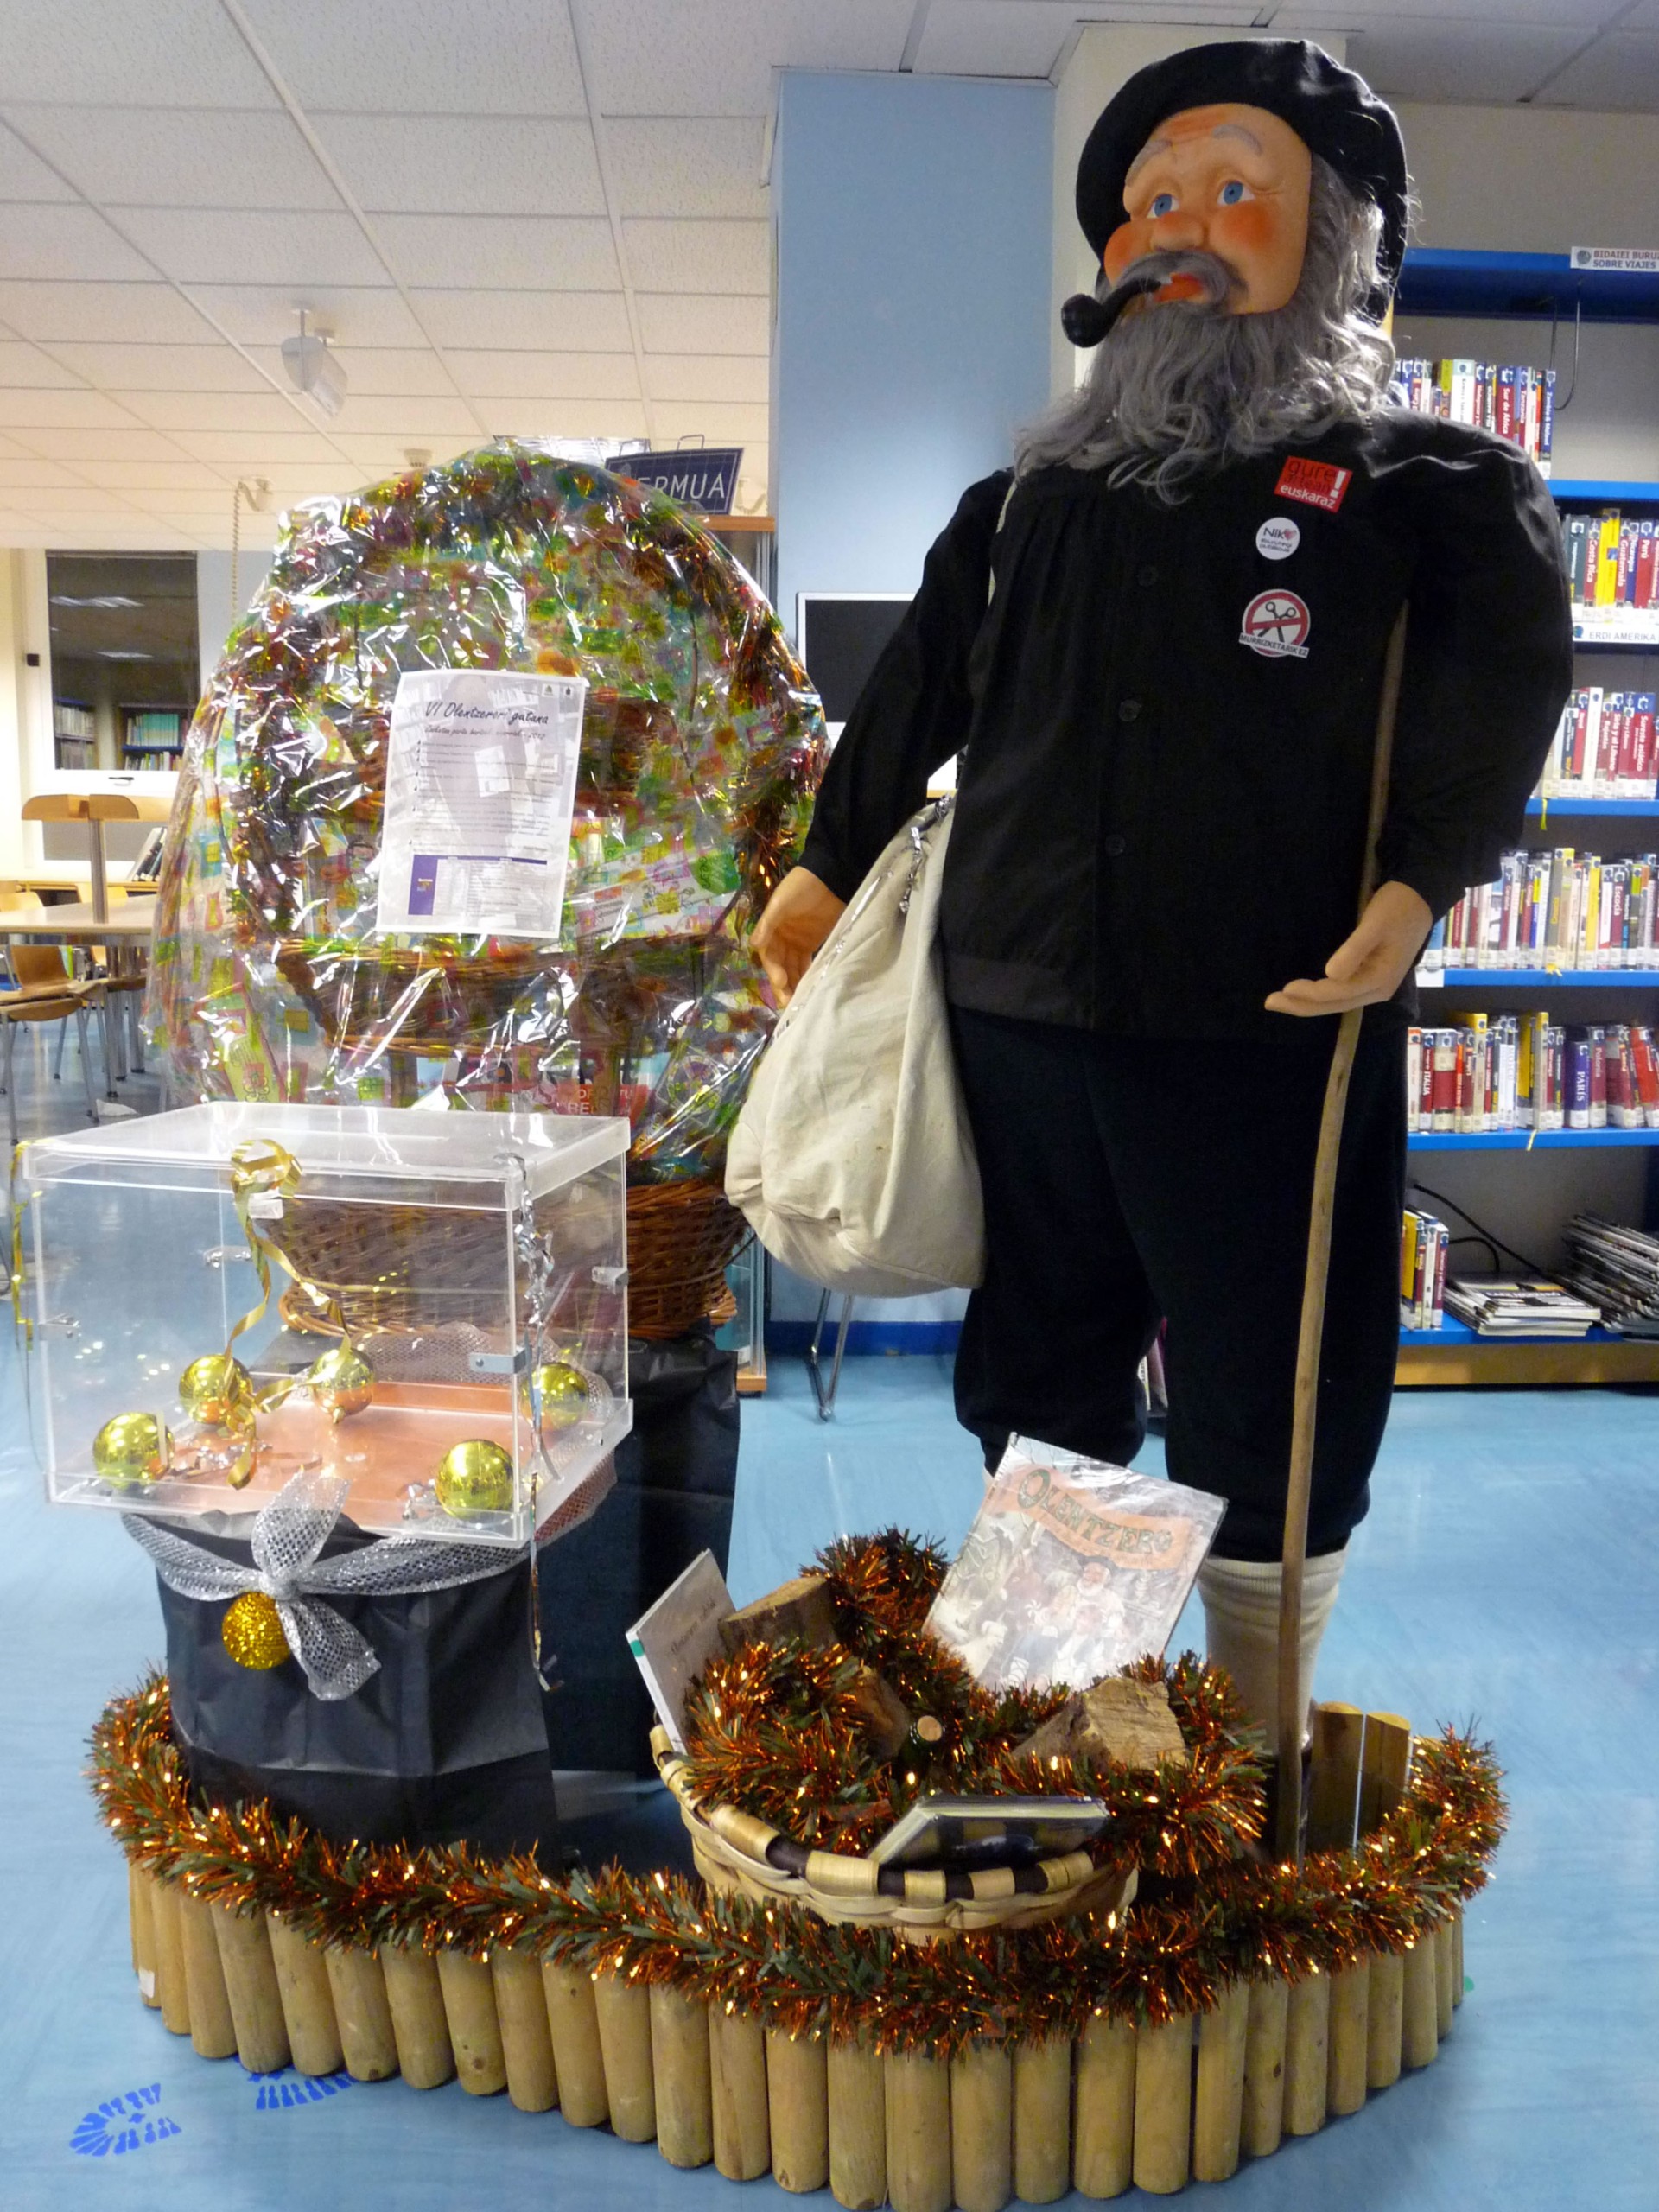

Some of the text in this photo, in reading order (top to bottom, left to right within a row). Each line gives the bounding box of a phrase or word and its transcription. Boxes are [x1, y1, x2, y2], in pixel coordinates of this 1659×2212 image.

[1593, 250, 1629, 258] BIDAIEI
[1593, 259, 1656, 269] SOBRE VIAJES
[1503, 401, 1510, 410] de
[1288, 459, 1336, 481] gure
[1280, 484, 1335, 509] euskaraz
[1263, 527, 1284, 539] Nik
[1586, 539, 1597, 583] Costa Rica
[1628, 539, 1637, 572] Nicaragua
[1641, 539, 1650, 559] Perú
[1618, 539, 1628, 587] Guatemala
[1614, 632, 1656, 641] AMERIKA
[1637, 715, 1648, 772] Sureste asiático
[1613, 886, 1623, 916] Escocia
[1422, 1071, 1431, 1096] ITALIA
[1577, 1071, 1586, 1102] PARÍS
[1017, 1468, 1173, 1554] OLENTZERO
